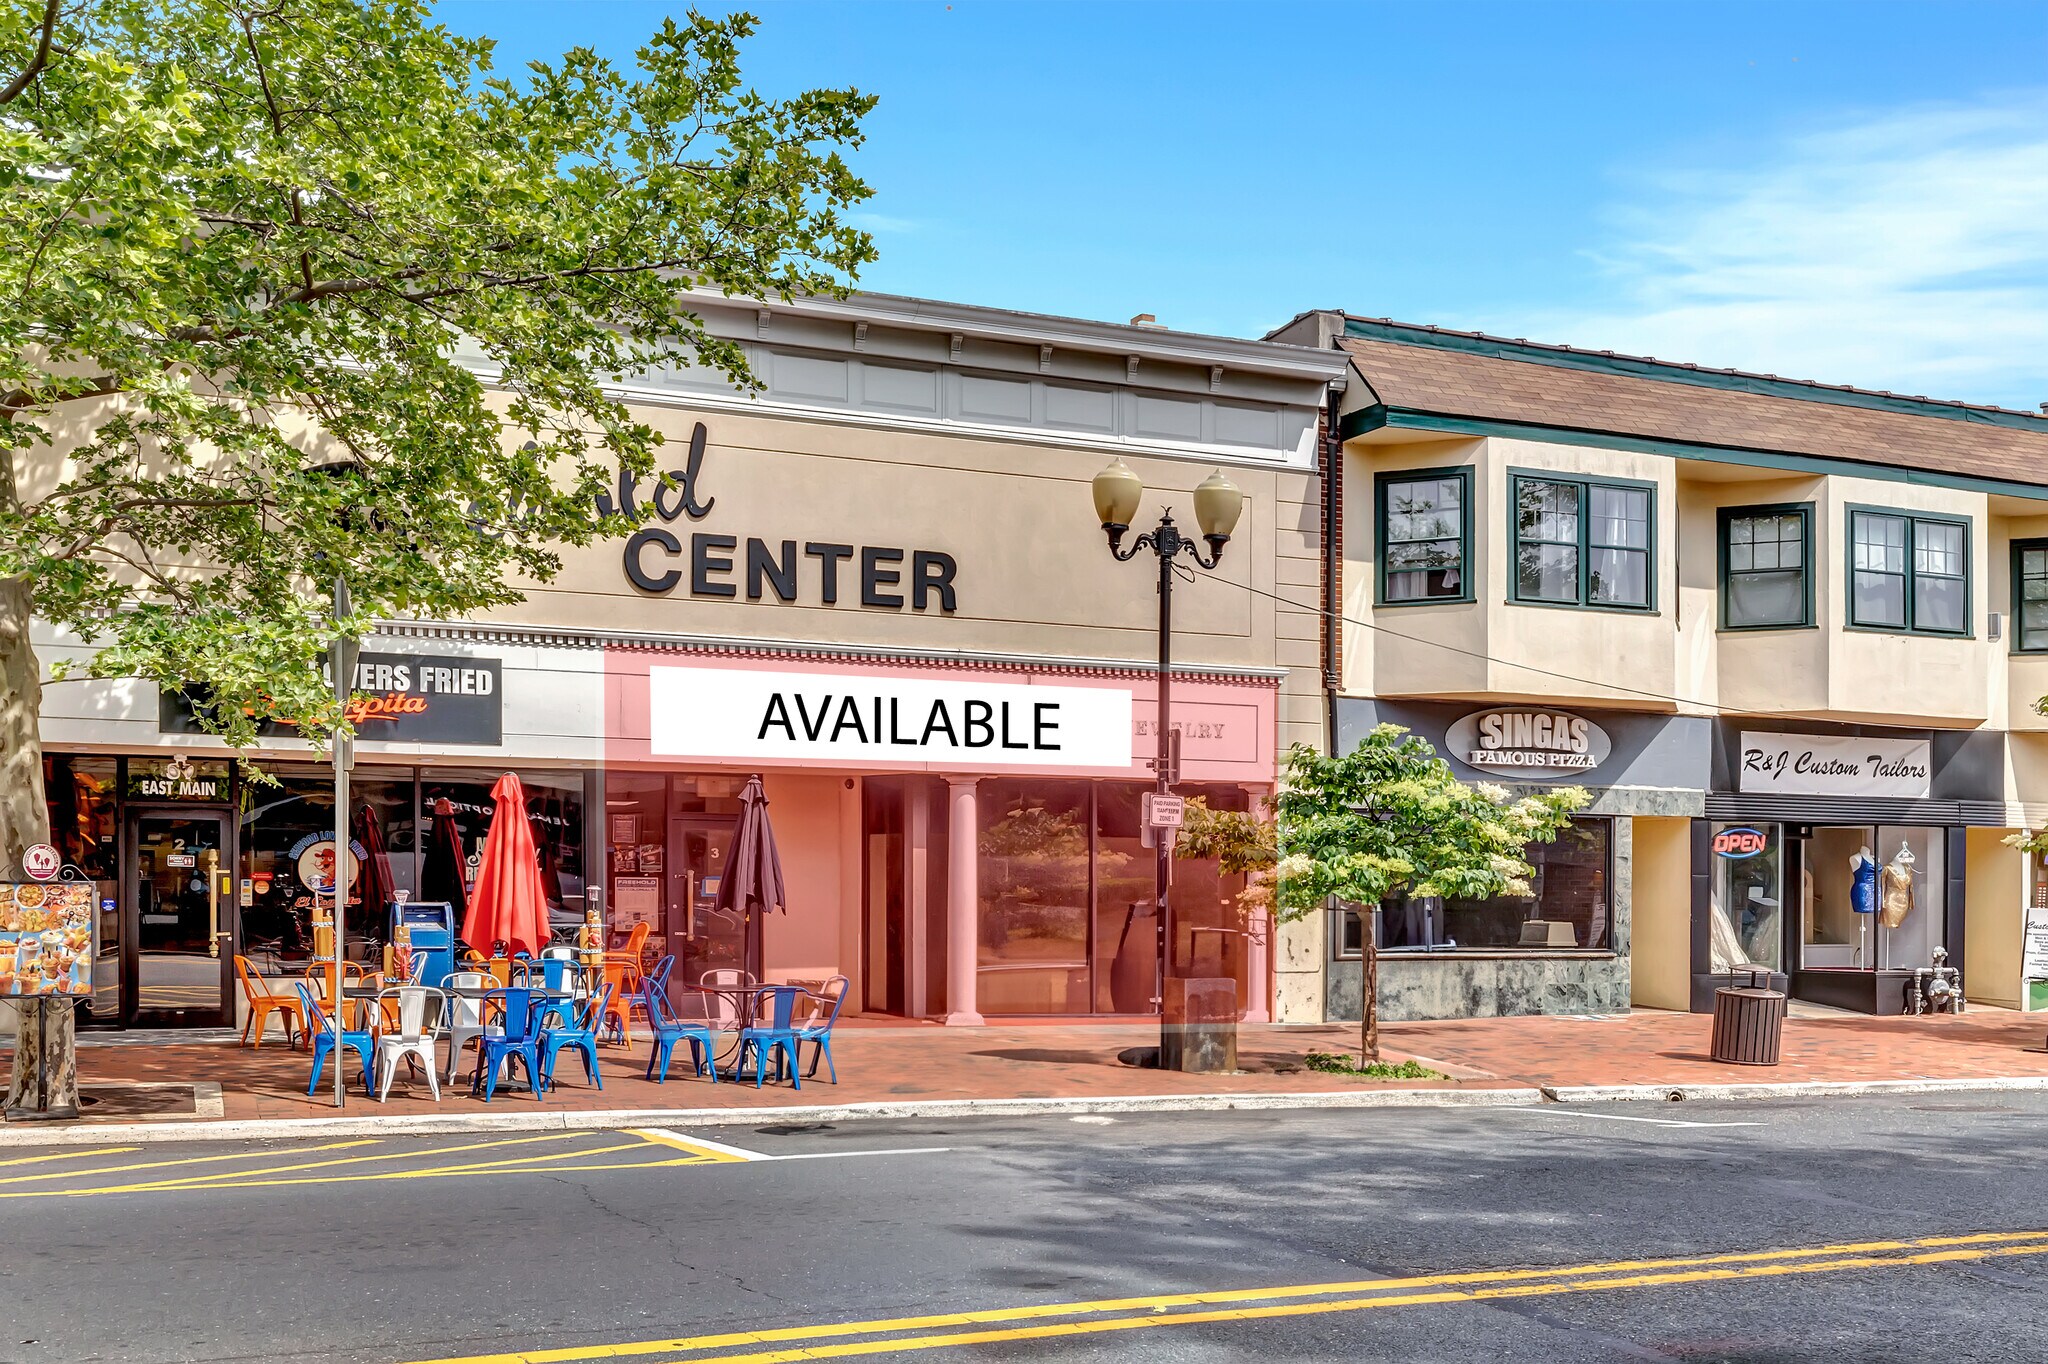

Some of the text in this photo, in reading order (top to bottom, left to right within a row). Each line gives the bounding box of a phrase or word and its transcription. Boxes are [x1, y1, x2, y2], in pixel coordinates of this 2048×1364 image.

[622, 527, 958, 614] CENTER
[420, 666, 493, 696] FRIED
[1480, 713, 1588, 753] SINGAS
[1471, 750, 1597, 768] FAMOUS PIZZA
[1743, 748, 1927, 780] R&J Custom Tailors
[142, 780, 216, 796] EAST MAIN
[174, 838, 185, 850] 2
[1713, 834, 1767, 852] OPEN
[710, 847, 720, 858] 3
